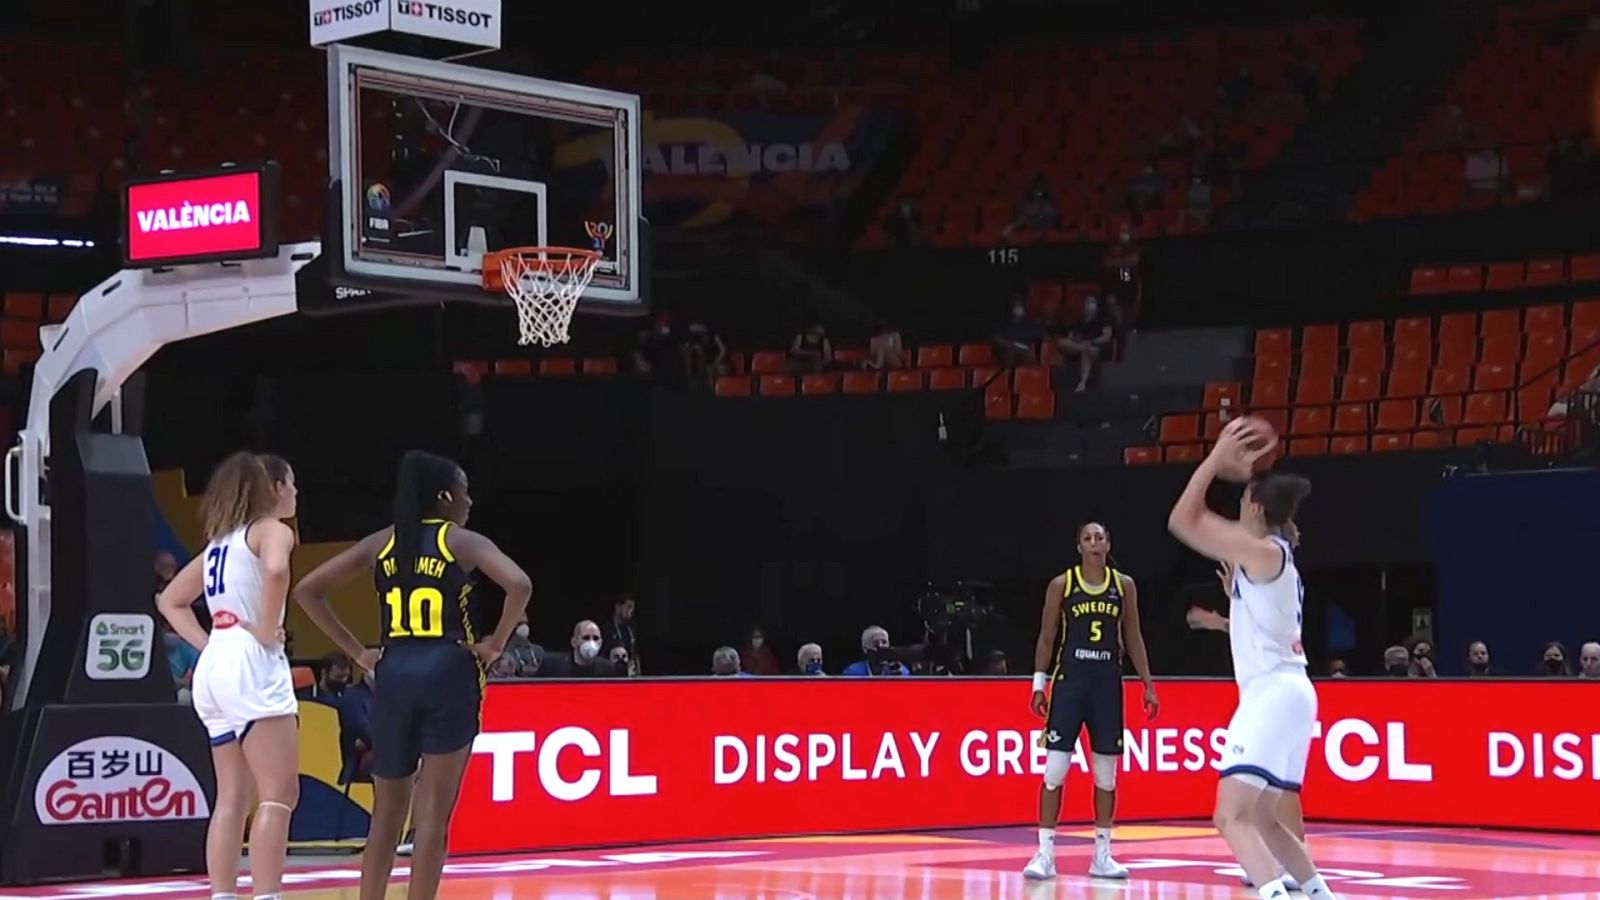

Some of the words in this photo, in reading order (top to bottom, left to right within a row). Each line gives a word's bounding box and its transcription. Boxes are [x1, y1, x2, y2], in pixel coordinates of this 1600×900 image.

[333, 0, 382, 22] TISSOT
[424, 4, 492, 28] TISSOT
[137, 200, 251, 233] VALÈNCIA
[988, 248, 1019, 264] 115
[206, 545, 229, 597] 31
[386, 587, 443, 638] 10
[1071, 600, 1119, 618] SWEDEN
[110, 623, 145, 636] Smart
[1089, 620, 1102, 642] 5
[96, 639, 145, 671] 5G
[1074, 648, 1113, 661] EQUALITY
[67, 750, 163, 780] 百岁山
[472, 725, 657, 803] TCL
[713, 730, 940, 784] DISPLAY
[1311, 718, 1433, 783] CL
[1488, 731, 1600, 781] DIS
